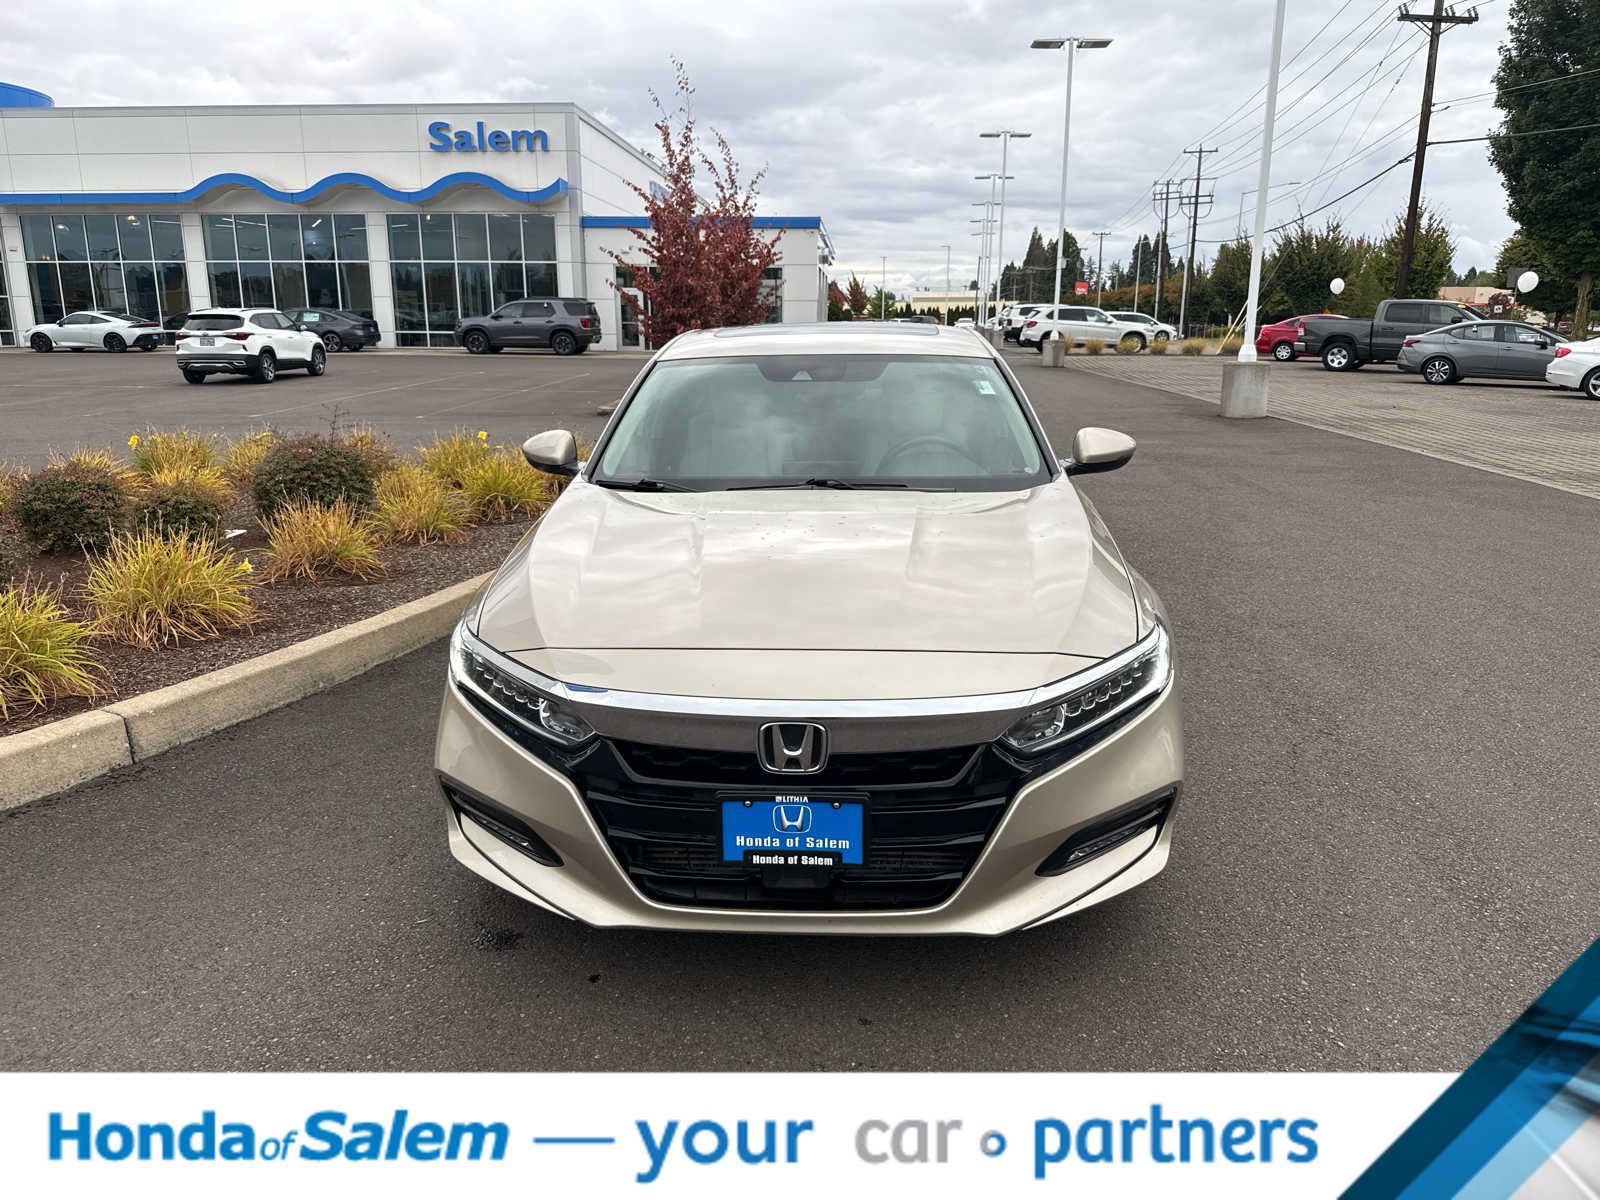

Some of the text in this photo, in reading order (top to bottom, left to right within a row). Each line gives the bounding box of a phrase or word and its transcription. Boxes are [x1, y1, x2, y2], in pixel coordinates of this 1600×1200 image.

[427, 121, 549, 152] Salem
[782, 795, 809, 803] LITHIA
[736, 835, 850, 849] Honda of Salem
[752, 854, 833, 866] Honda of Salem
